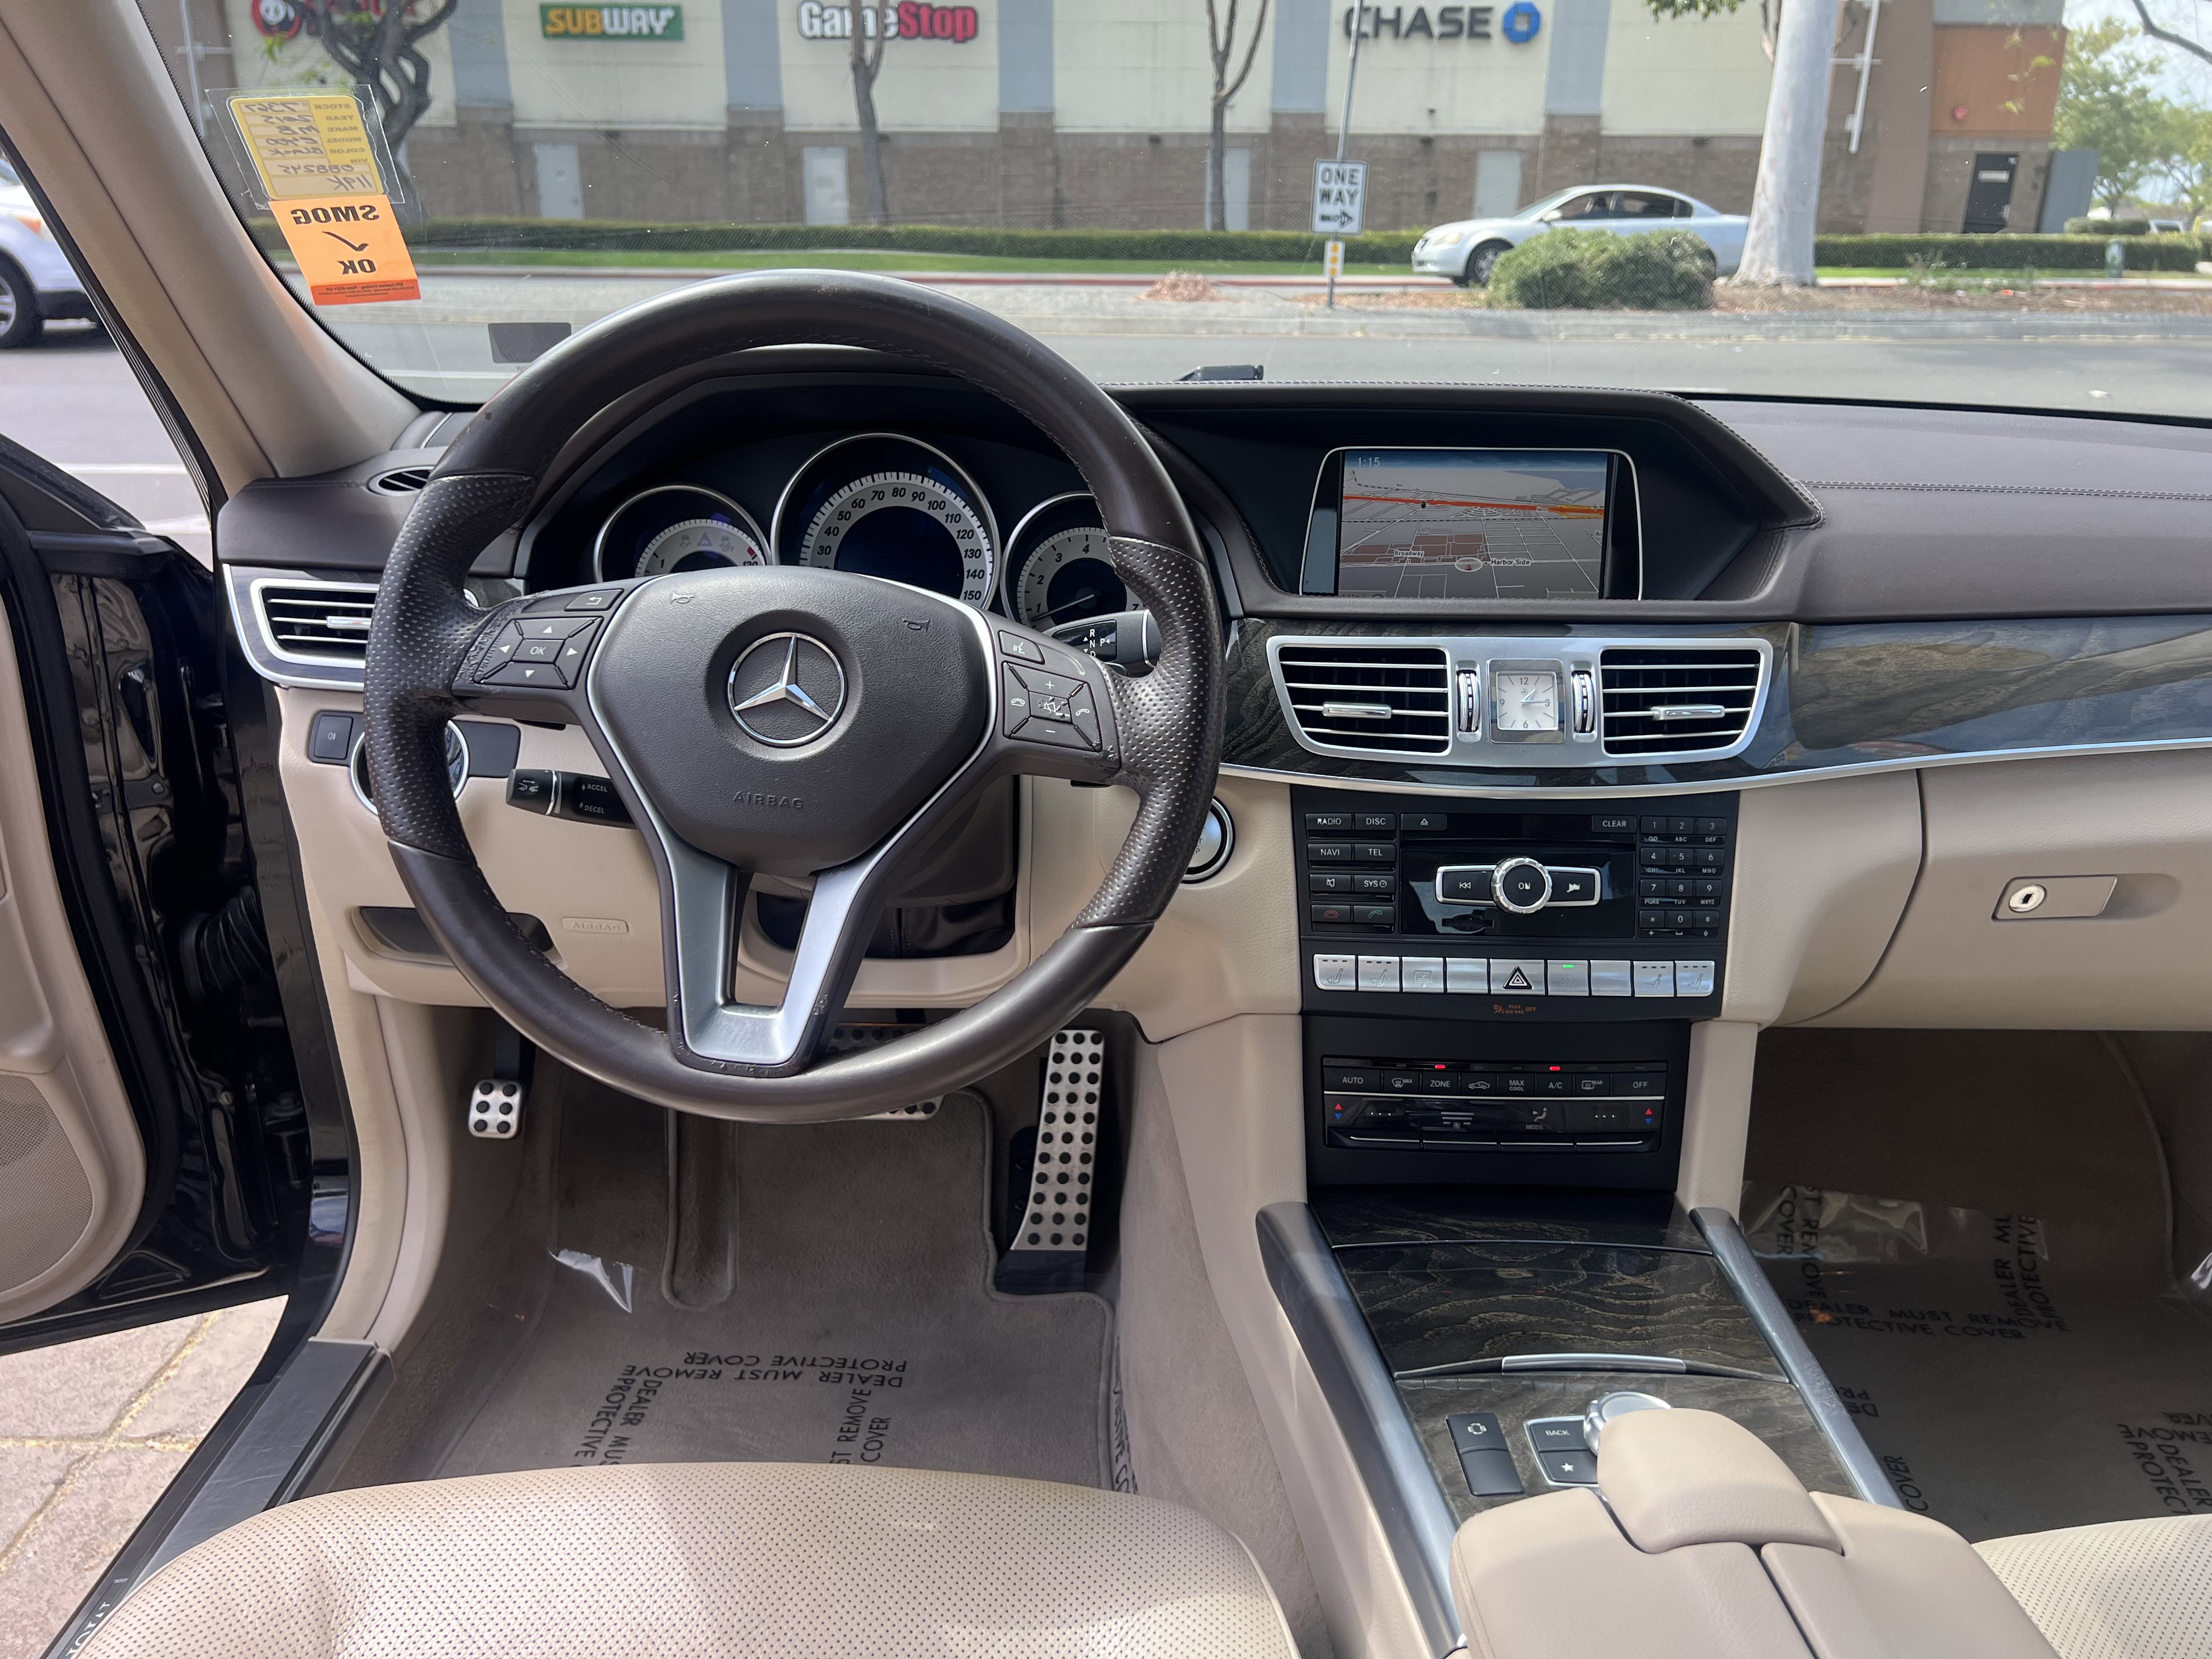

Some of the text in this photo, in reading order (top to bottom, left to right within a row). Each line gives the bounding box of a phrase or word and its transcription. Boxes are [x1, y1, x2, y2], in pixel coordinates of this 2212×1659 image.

[545, 8, 675, 35] SUBWAY
[1344, 5, 1495, 40] CHASE
[1321, 167, 1360, 185] ONE
[1319, 187, 1360, 206] WAY
[1357, 456, 1380, 467] 1:15
[871, 490, 885, 500] 70
[892, 488, 906, 498] 80
[911, 492, 926, 501] 90
[851, 499, 866, 509] 60
[928, 500, 946, 510] 100
[837, 511, 851, 521] 50
[945, 514, 961, 523] 110
[824, 527, 839, 537] 40
[957, 529, 974, 539] 120
[817, 545, 832, 555] 30
[964, 549, 981, 558] 130
[1082, 544, 1090, 554] 4
[1055, 553, 1063, 562] 3
[966, 569, 985, 579] 140
[1036, 575, 1045, 585] 2
[963, 590, 981, 600] 150
[1036, 602, 1041, 612] 1
[1090, 629, 1095, 637] R
[1089, 640, 1096, 648] N
[1099, 638, 1105, 647] P
[530, 646, 546, 656] OK
[1519, 677, 1529, 685] 12
[587, 783, 608, 793] ACCEL
[733, 791, 804, 809] AIRBAG
[584, 804, 605, 814] DECEL
[1602, 820, 1627, 828] CLEAR
[1518, 882, 1531, 890] ON
[1776, 1185, 1797, 1256] COVER
[1944, 1324, 2027, 1340] COVER
[684, 1351, 907, 1372] PROTECTIVE COVER
[622, 1365, 903, 1387] DEALER MUST REMOVE
[620, 1379, 662, 1426] DEALER
[574, 1378, 636, 1458] PROTECTIVE
[837, 1388, 871, 1442] REMOVE
[860, 1417, 891, 1462] COVER
[1883, 1455, 1929, 1511] COVER
